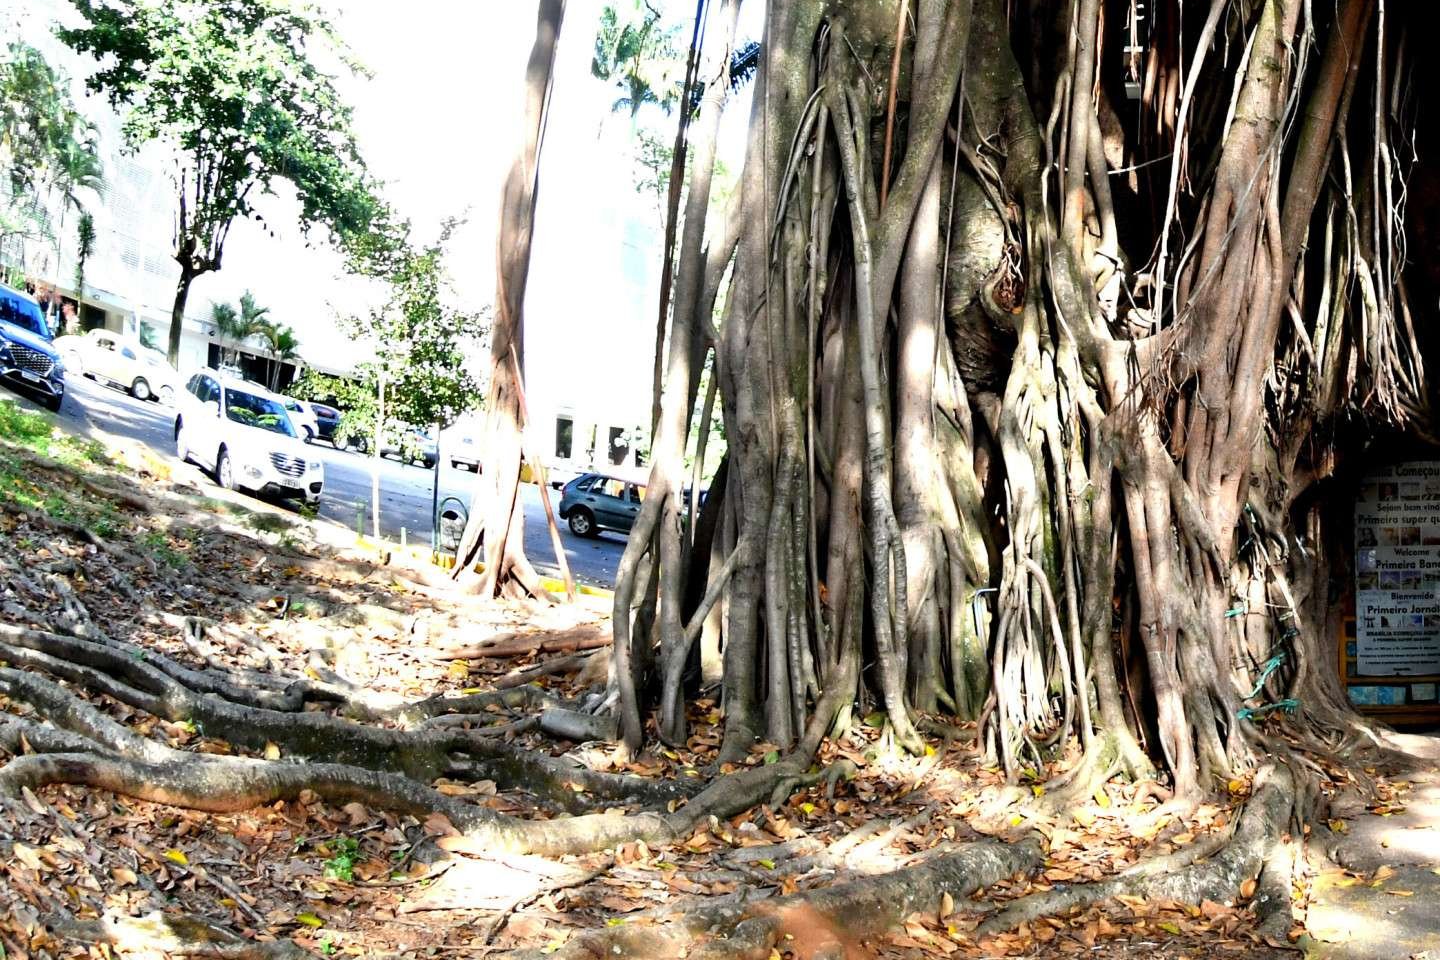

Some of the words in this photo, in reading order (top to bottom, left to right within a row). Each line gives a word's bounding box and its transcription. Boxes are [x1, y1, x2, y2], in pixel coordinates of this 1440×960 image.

[1395, 464, 1440, 478] Começou
[1402, 516, 1428, 526] super
[1393, 547, 1430, 557] Welcome
[1390, 591, 1435, 601] Bienvenido
